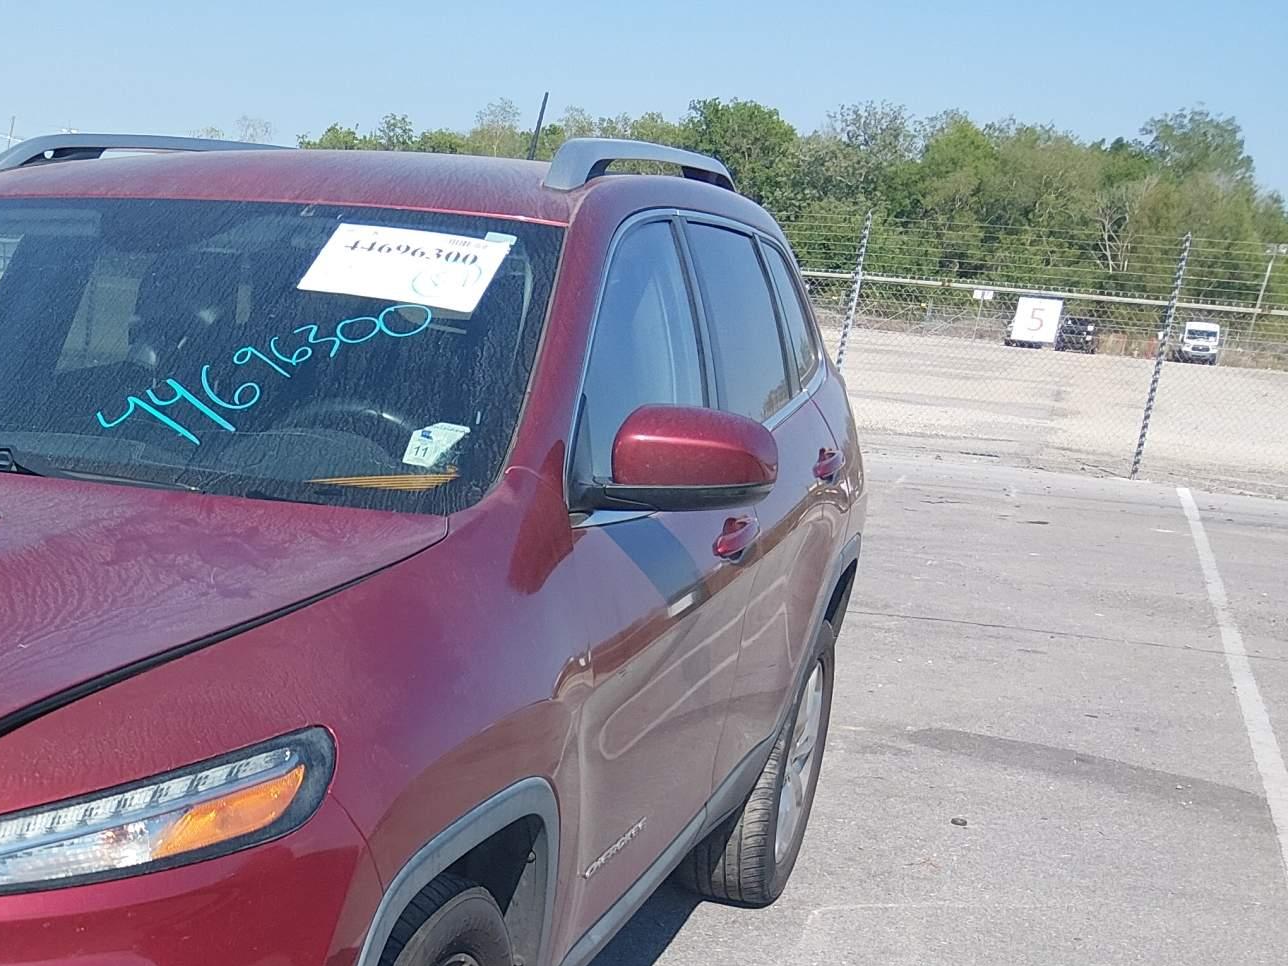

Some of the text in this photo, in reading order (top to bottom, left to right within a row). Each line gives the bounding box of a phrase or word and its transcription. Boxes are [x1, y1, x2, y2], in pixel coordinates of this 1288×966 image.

[344, 239, 478, 266] 44696300
[1027, 308, 1045, 331] 5
[96, 303, 431, 446] 44696300
[413, 445, 429, 458] 11
